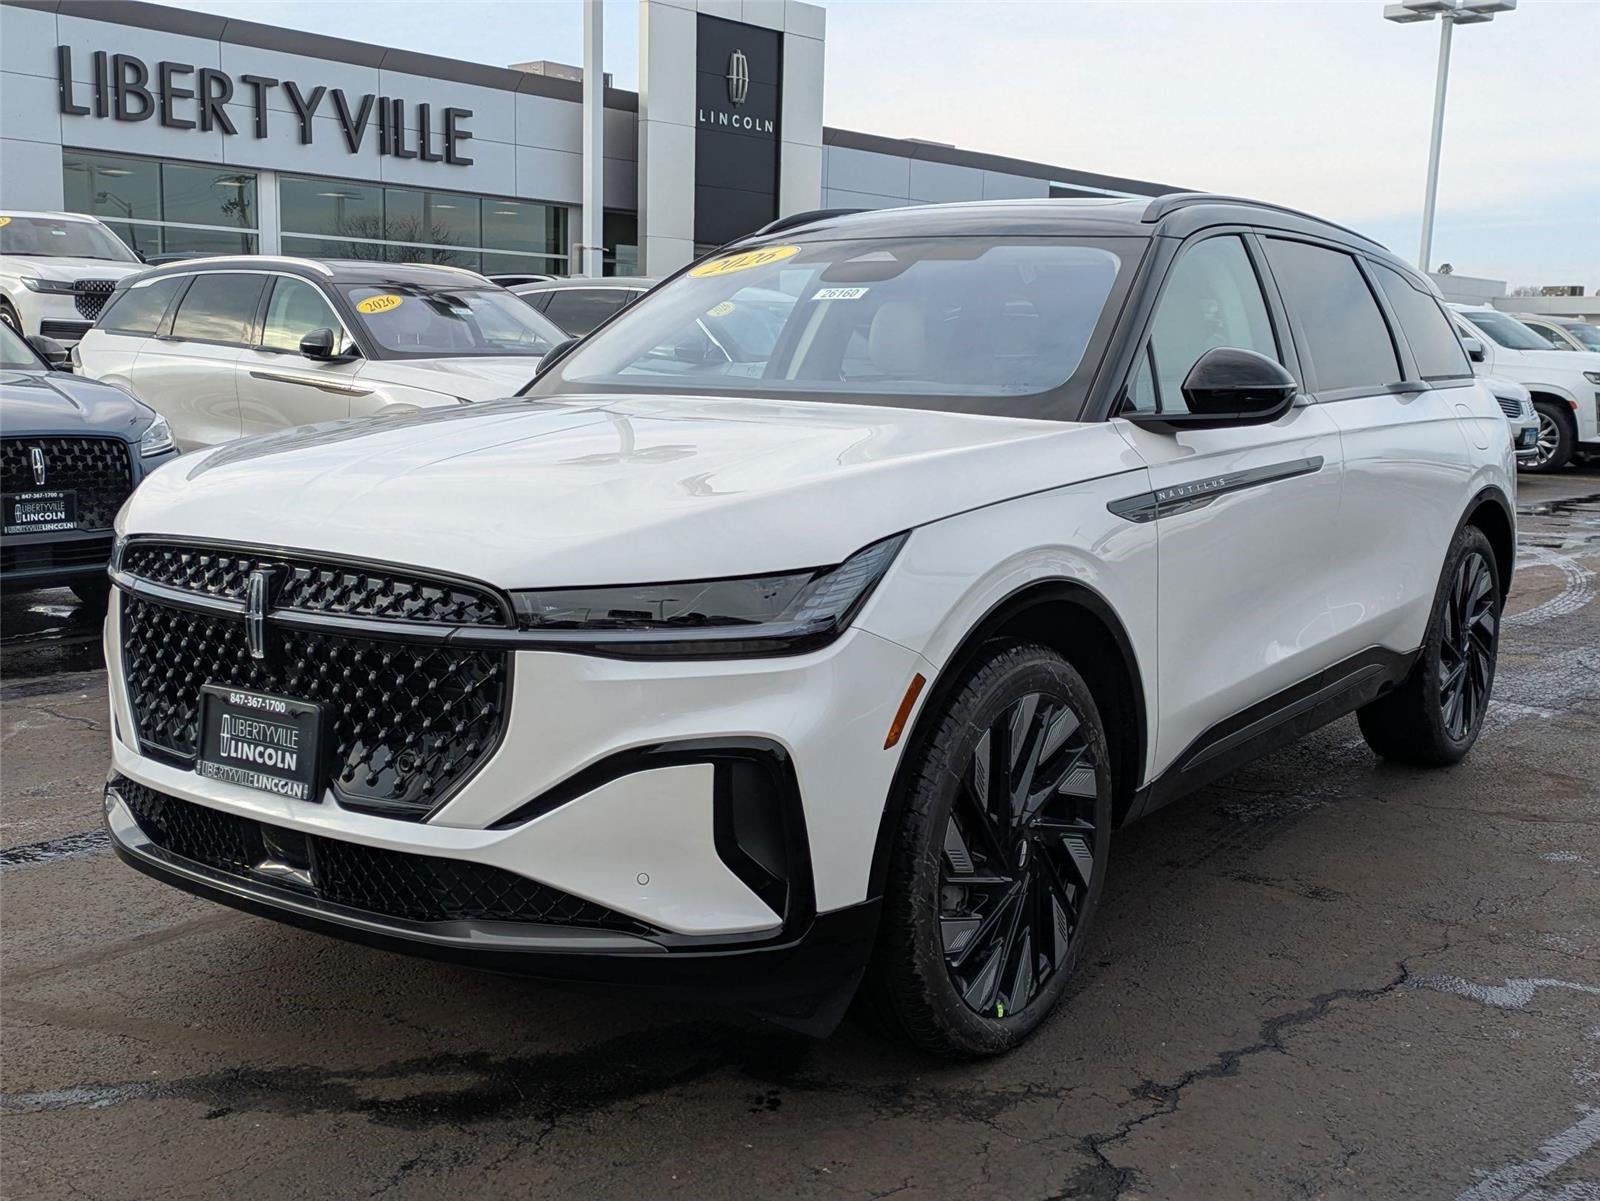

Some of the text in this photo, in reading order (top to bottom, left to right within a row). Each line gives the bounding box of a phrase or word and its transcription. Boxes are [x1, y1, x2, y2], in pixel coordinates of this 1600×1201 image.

[58, 45, 474, 166] LIBERTYVILLE
[700, 109, 773, 133] LINCOLN
[365, 296, 395, 312] 2026
[820, 289, 860, 298] 26160
[1159, 478, 1226, 500] NAUTILUS
[22, 512, 65, 522] LINCOLN
[230, 693, 286, 713] 847-367-1700
[231, 718, 299, 749] LIBERTYVILLE
[230, 741, 297, 771] LINCOLN
